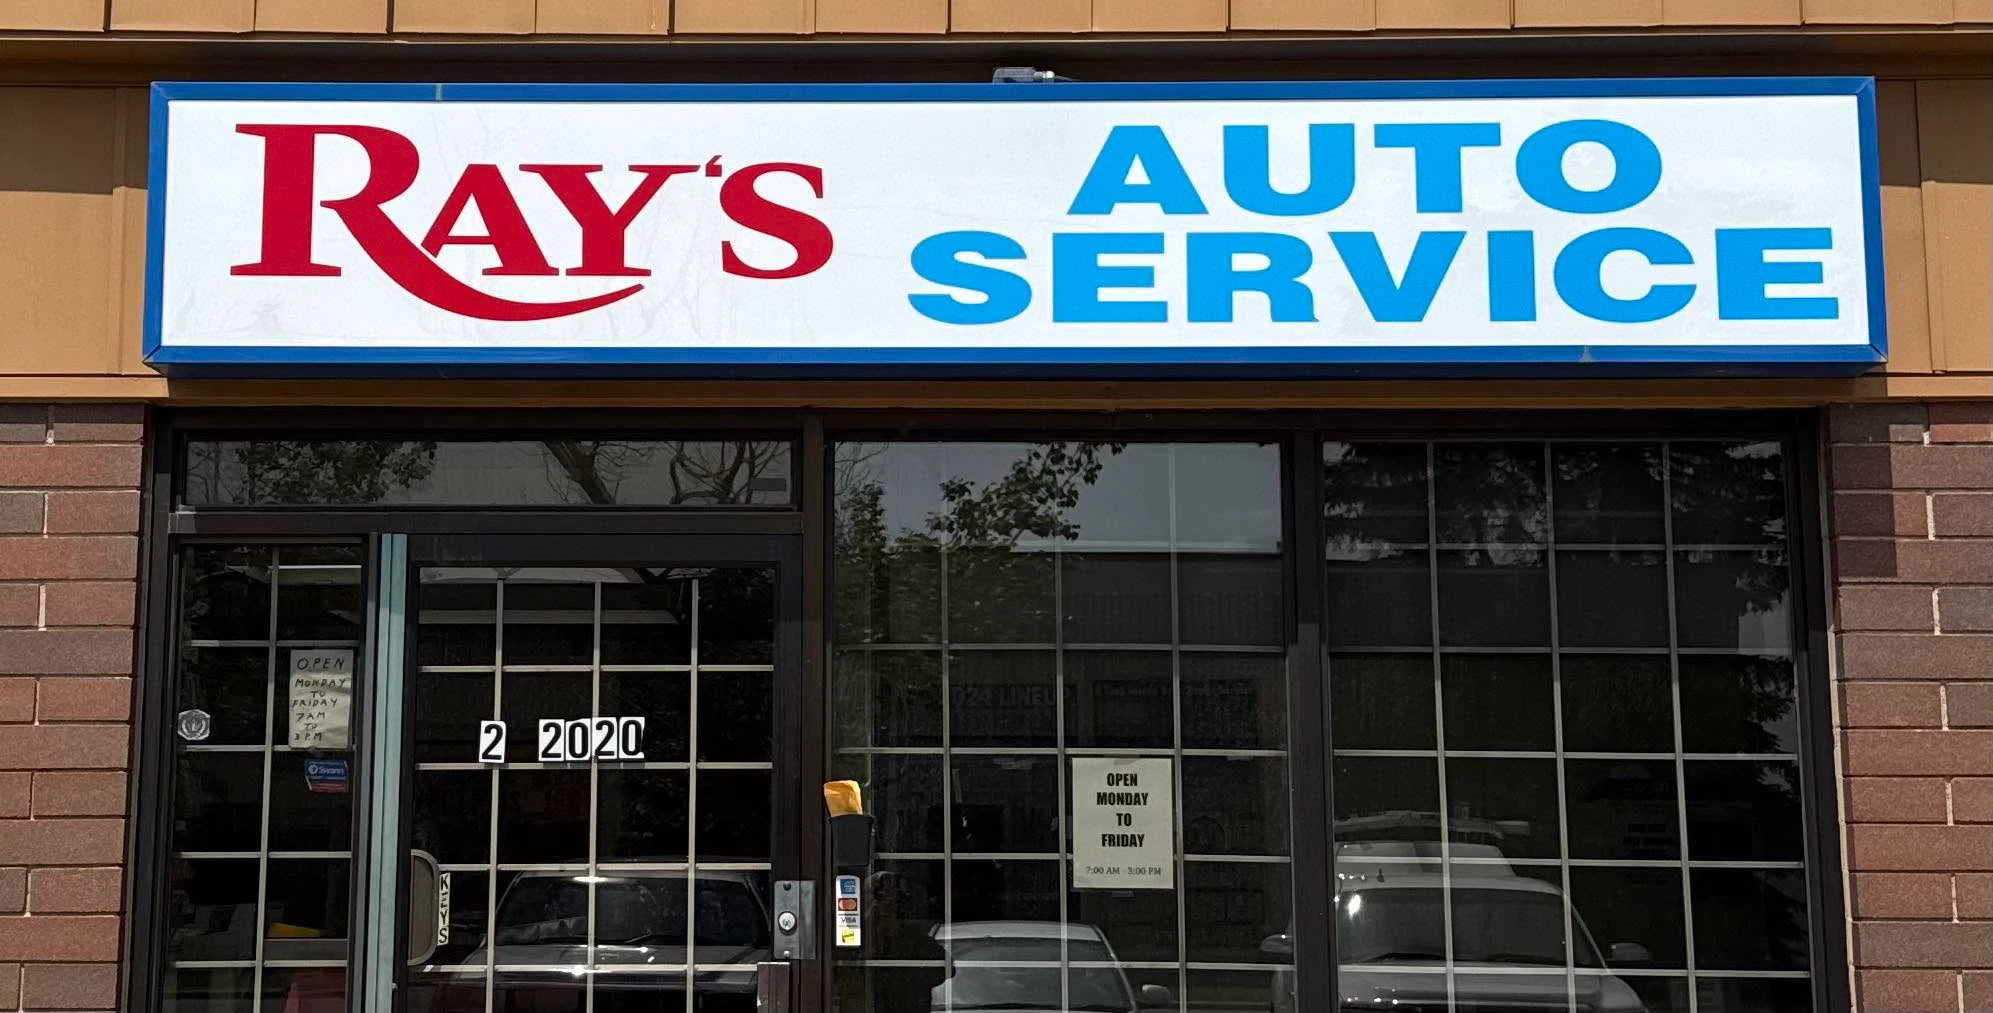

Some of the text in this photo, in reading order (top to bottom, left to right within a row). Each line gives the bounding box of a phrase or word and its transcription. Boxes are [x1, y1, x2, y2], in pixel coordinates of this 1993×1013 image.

[1065, 118, 1663, 216] AUTO
[907, 226, 1840, 326] SERVICE
[296, 657, 345, 671] OPEN
[295, 678, 346, 689] MONDAY
[310, 690, 326, 699] TO
[292, 698, 338, 709] FRIDAY
[304, 723, 318, 731] TO
[481, 719, 643, 760] 2 2020
[1106, 772, 1138, 787] OPEN
[1096, 791, 1149, 806] MONDAY
[1116, 812, 1132, 827] TO
[1101, 833, 1145, 848] FRIDAY
[1086, 866, 1162, 876] 7:00 AM 3:00 PM
[438, 874, 449, 944] KEYS
[840, 916, 857, 924] VISA
